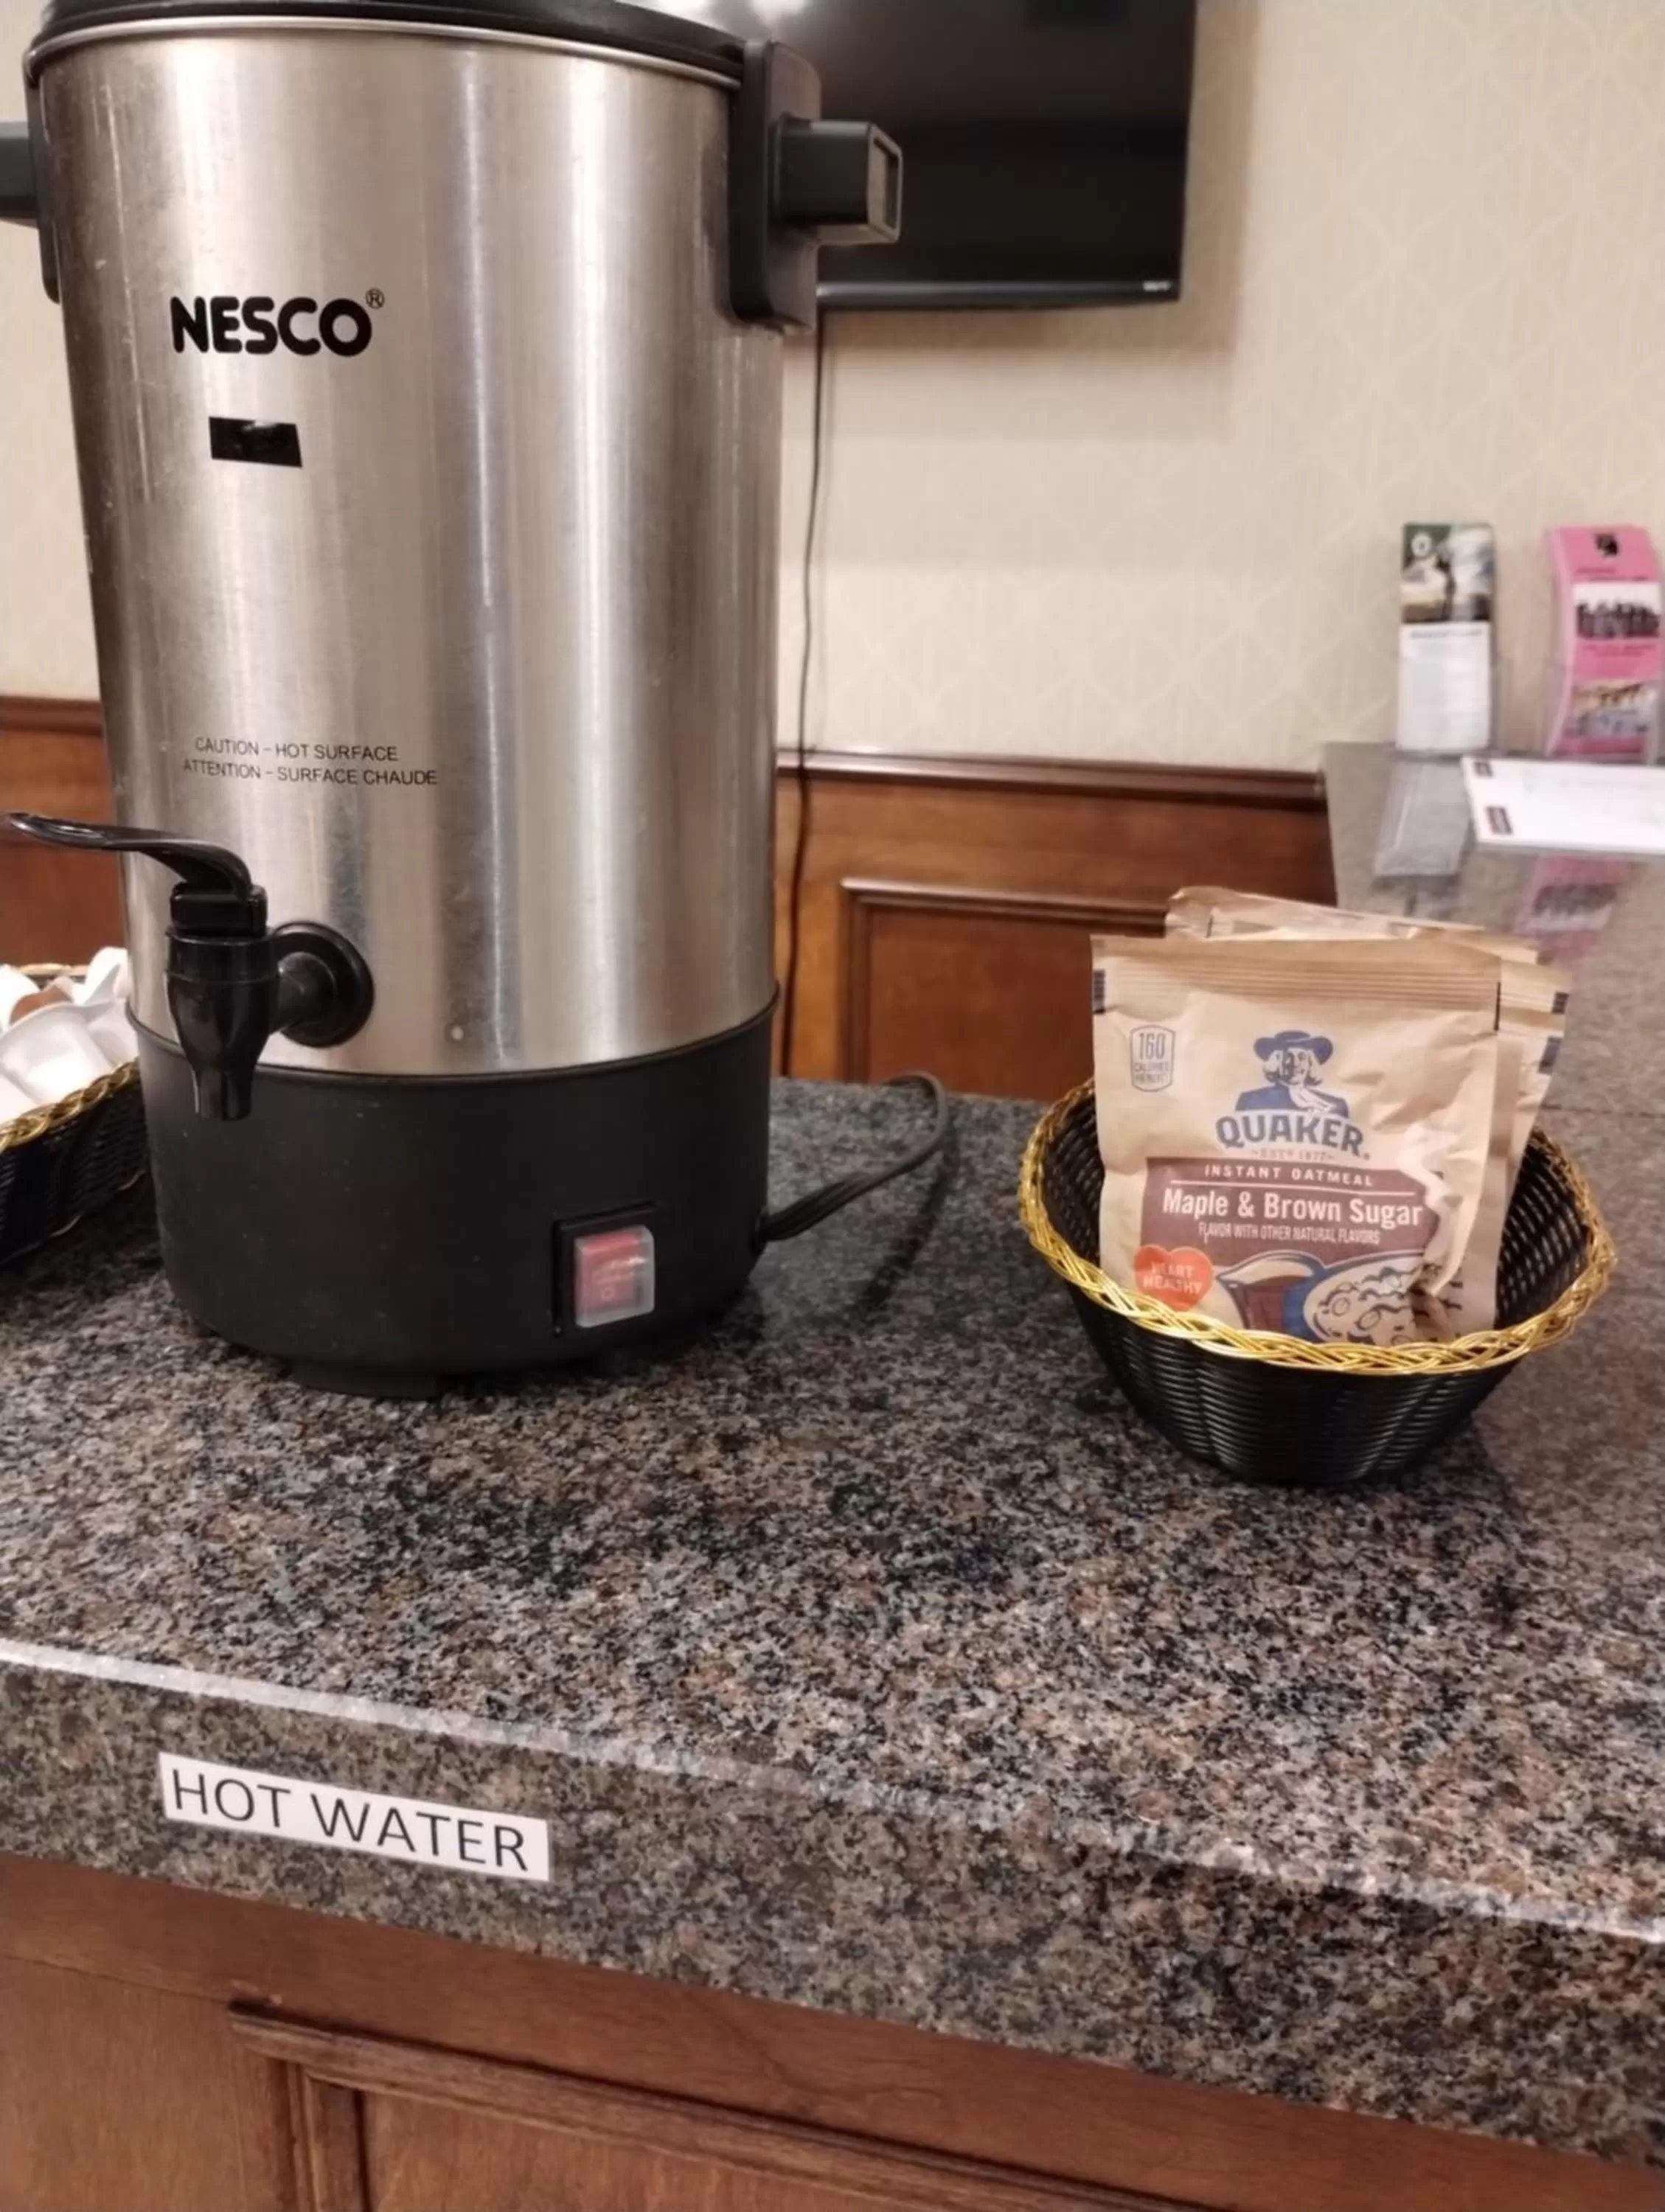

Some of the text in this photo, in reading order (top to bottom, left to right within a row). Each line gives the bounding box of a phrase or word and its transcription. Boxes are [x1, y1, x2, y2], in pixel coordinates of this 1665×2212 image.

[170, 296, 372, 357] NESCO
[195, 737, 260, 756] CAUTION
[276, 743, 310, 759] HOT
[314, 745, 398, 762] SURFACE
[183, 759, 261, 779] ATTENTION
[277, 768, 358, 785] SURFACE
[364, 770, 439, 786] CHAUDE
[1139, 1032, 1166, 1060] 160
[1215, 1114, 1364, 1157] QUAKER
[1204, 1164, 1373, 1186] INSTANT OATMEAL
[1162, 1188, 1423, 1230] Maple & Brown Sugar
[1198, 1221, 1231, 1239] FLAVOR
[1233, 1222, 1259, 1239] WITH
[1260, 1224, 1290, 1241] OTHER
[1293, 1225, 1336, 1244] NATURAL
[172, 1768, 529, 1872] HOT WATER
